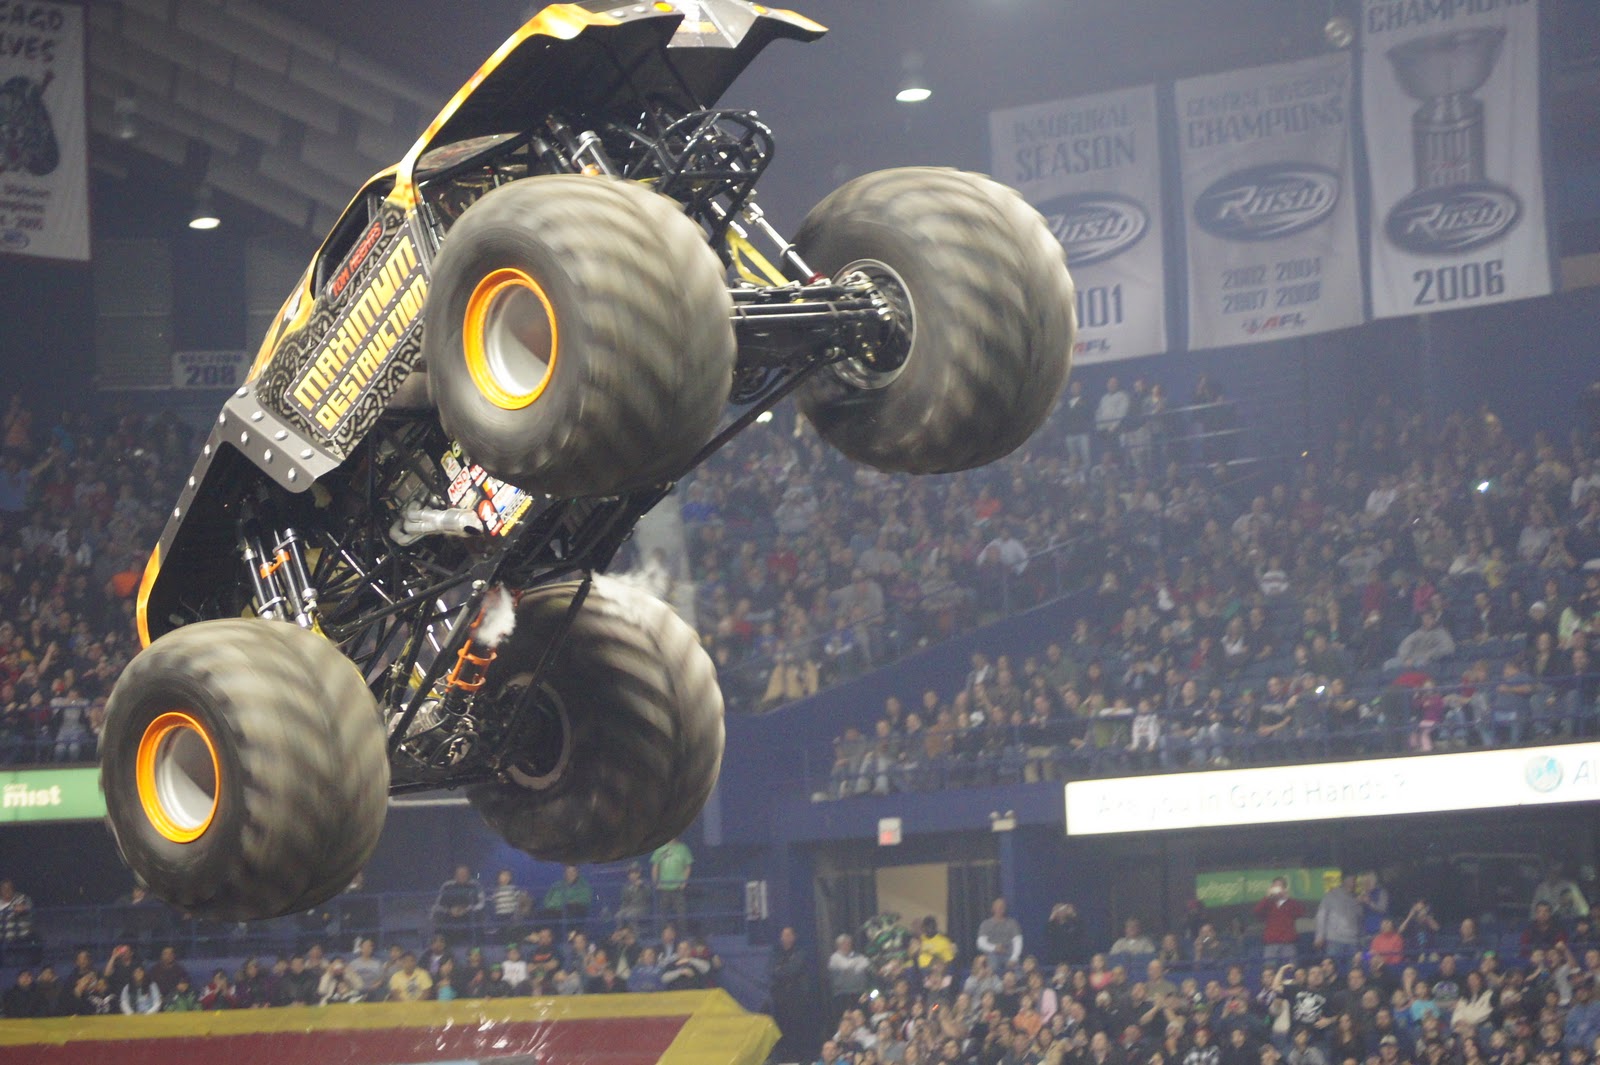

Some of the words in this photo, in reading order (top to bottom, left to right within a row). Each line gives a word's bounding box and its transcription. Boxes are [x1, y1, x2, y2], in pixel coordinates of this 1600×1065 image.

[1367, 0, 1529, 34] CHAMPI
[1188, 97, 1343, 148] CHAMPIONS
[1016, 130, 1137, 182] SEASON
[1077, 283, 1124, 328] 01
[1413, 258, 1506, 306] 2006
[292, 235, 418, 412] MAXIMUM
[315, 273, 429, 431] DESTRUCTION
[449, 470, 469, 496] MSD
[1229, 782, 1296, 811] Good
